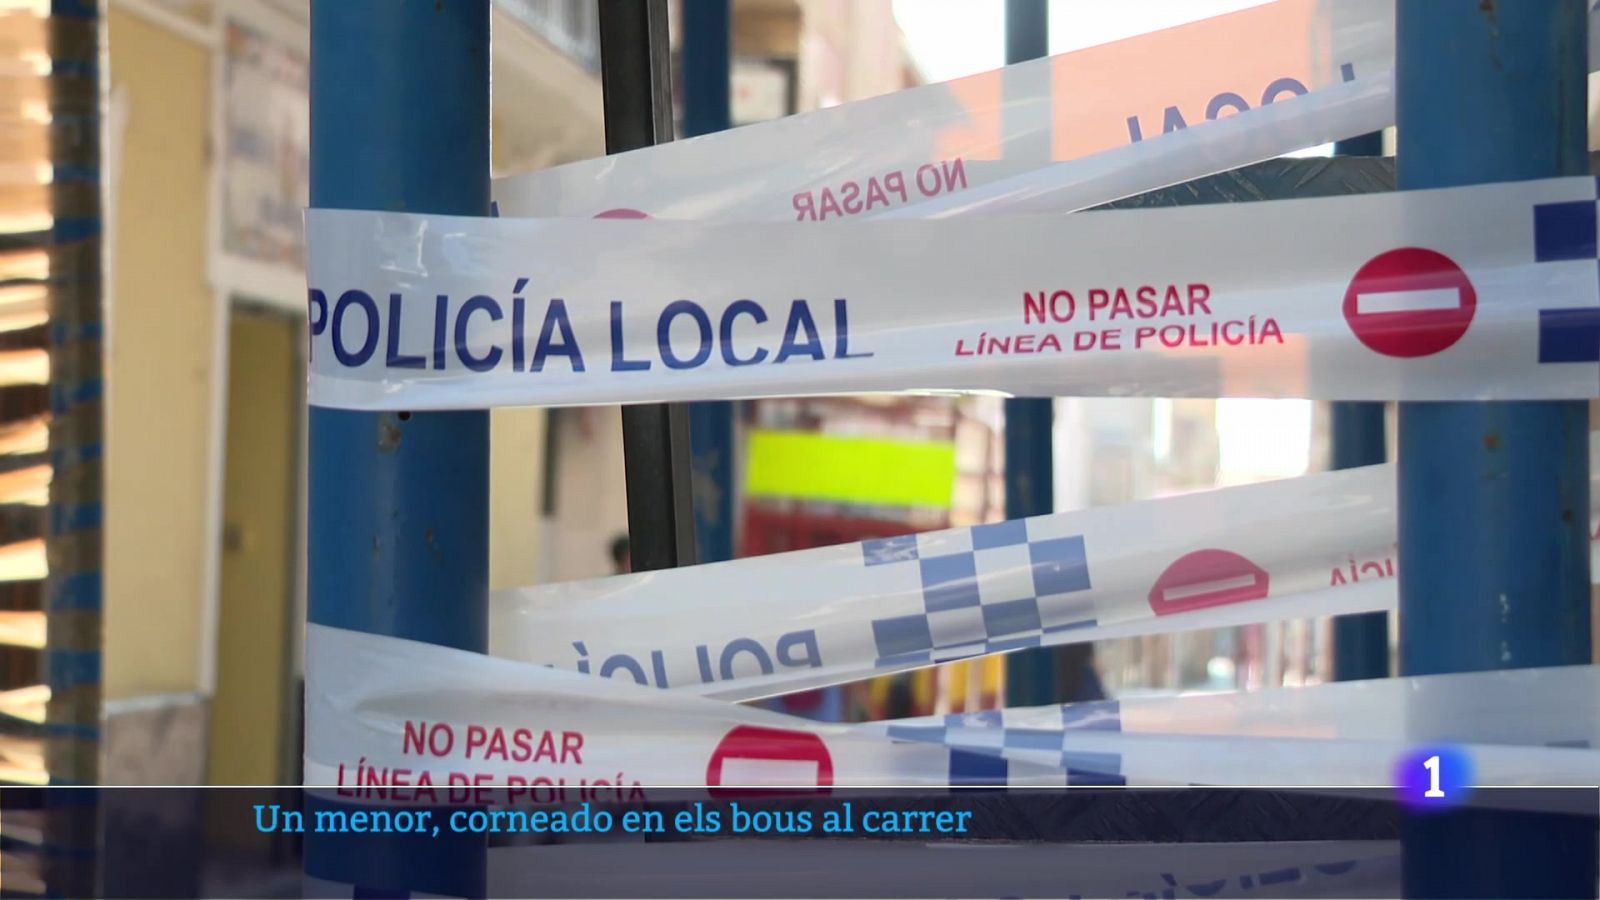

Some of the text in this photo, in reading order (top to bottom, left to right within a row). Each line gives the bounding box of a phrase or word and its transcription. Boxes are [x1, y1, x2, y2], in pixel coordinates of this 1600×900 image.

[308, 277, 875, 374] POLICÍA LOCAL
[1023, 283, 1213, 325] NO PASAR
[954, 315, 1285, 356] LÍNEA DE POLICÍA
[403, 720, 585, 764] NO PASAR
[336, 757, 434, 804] LÍNEA
[447, 772, 494, 806] DE
